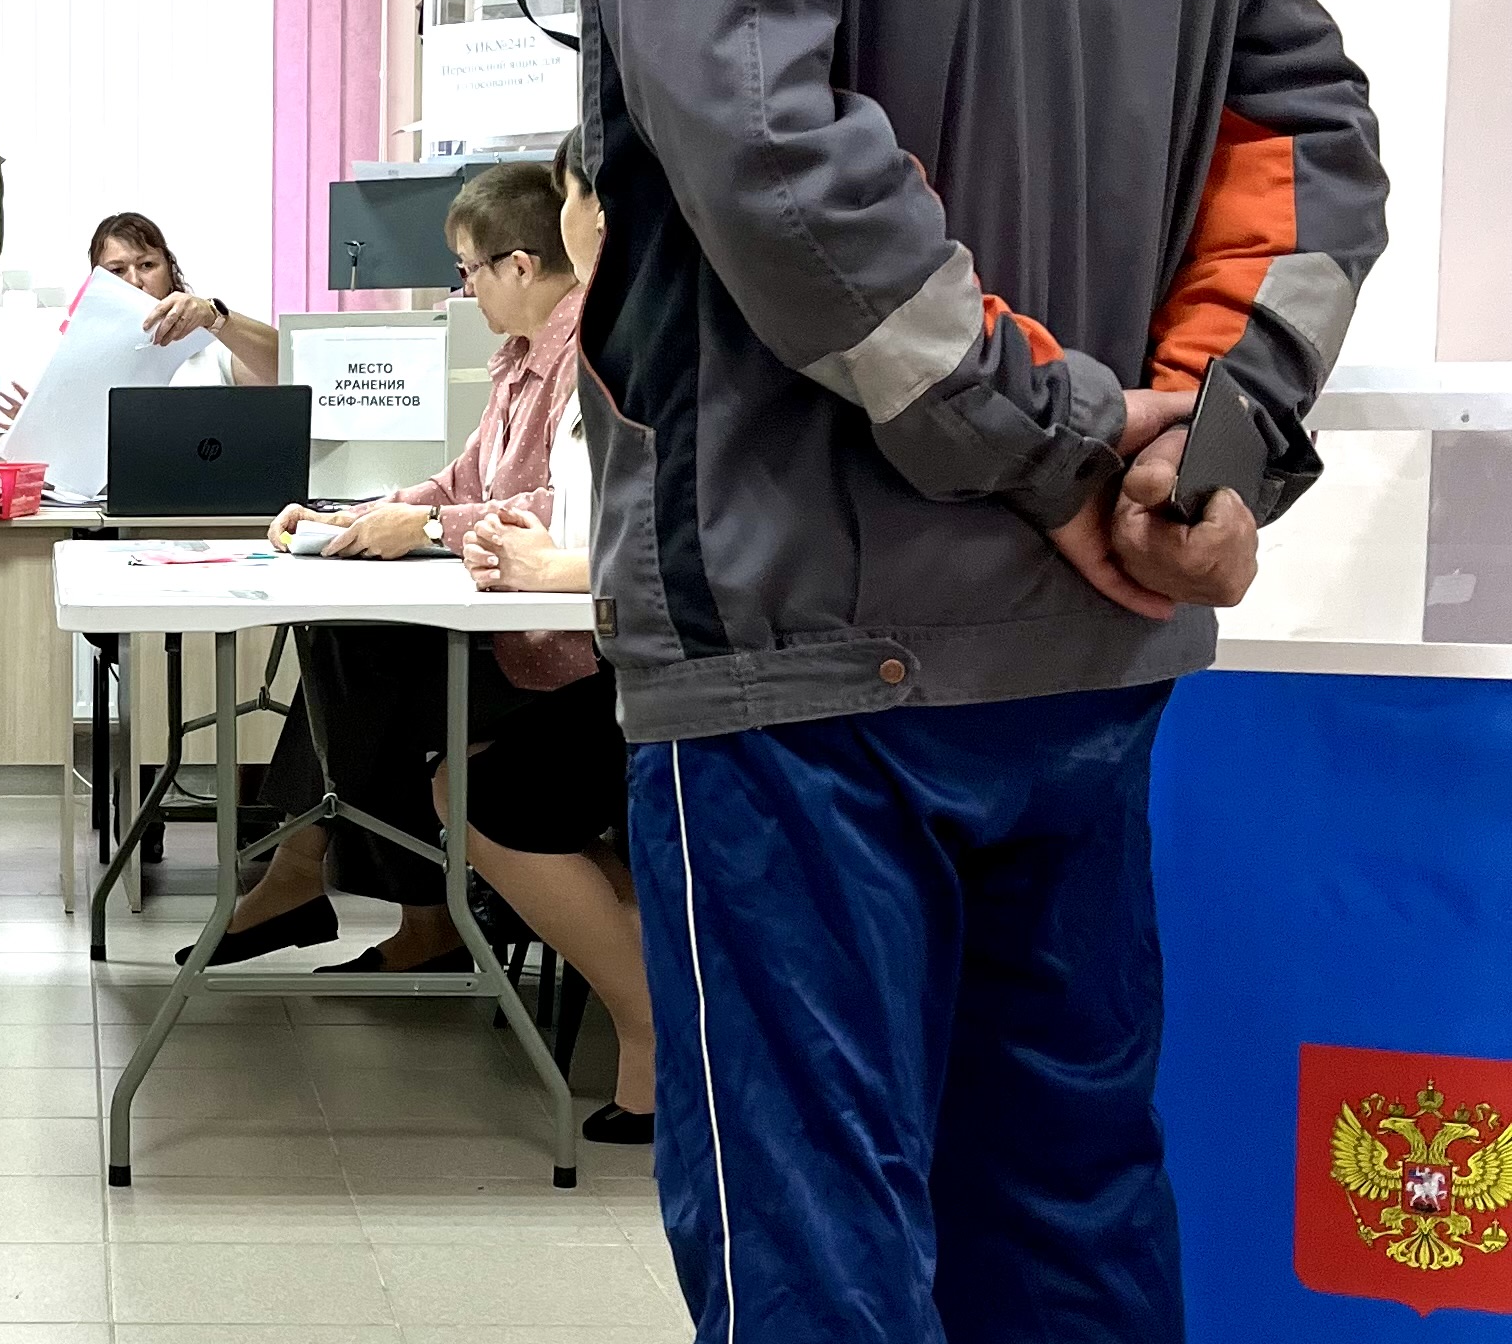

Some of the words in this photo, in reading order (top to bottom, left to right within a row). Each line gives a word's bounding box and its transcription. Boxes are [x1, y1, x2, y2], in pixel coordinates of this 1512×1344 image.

[347, 363, 394, 374] МЕСТО
[334, 379, 406, 391] ХРАНЕНИЯ
[318, 394, 422, 407] СЕЙФ-ПАКЕТОВ
[199, 438, 221, 461] hp
